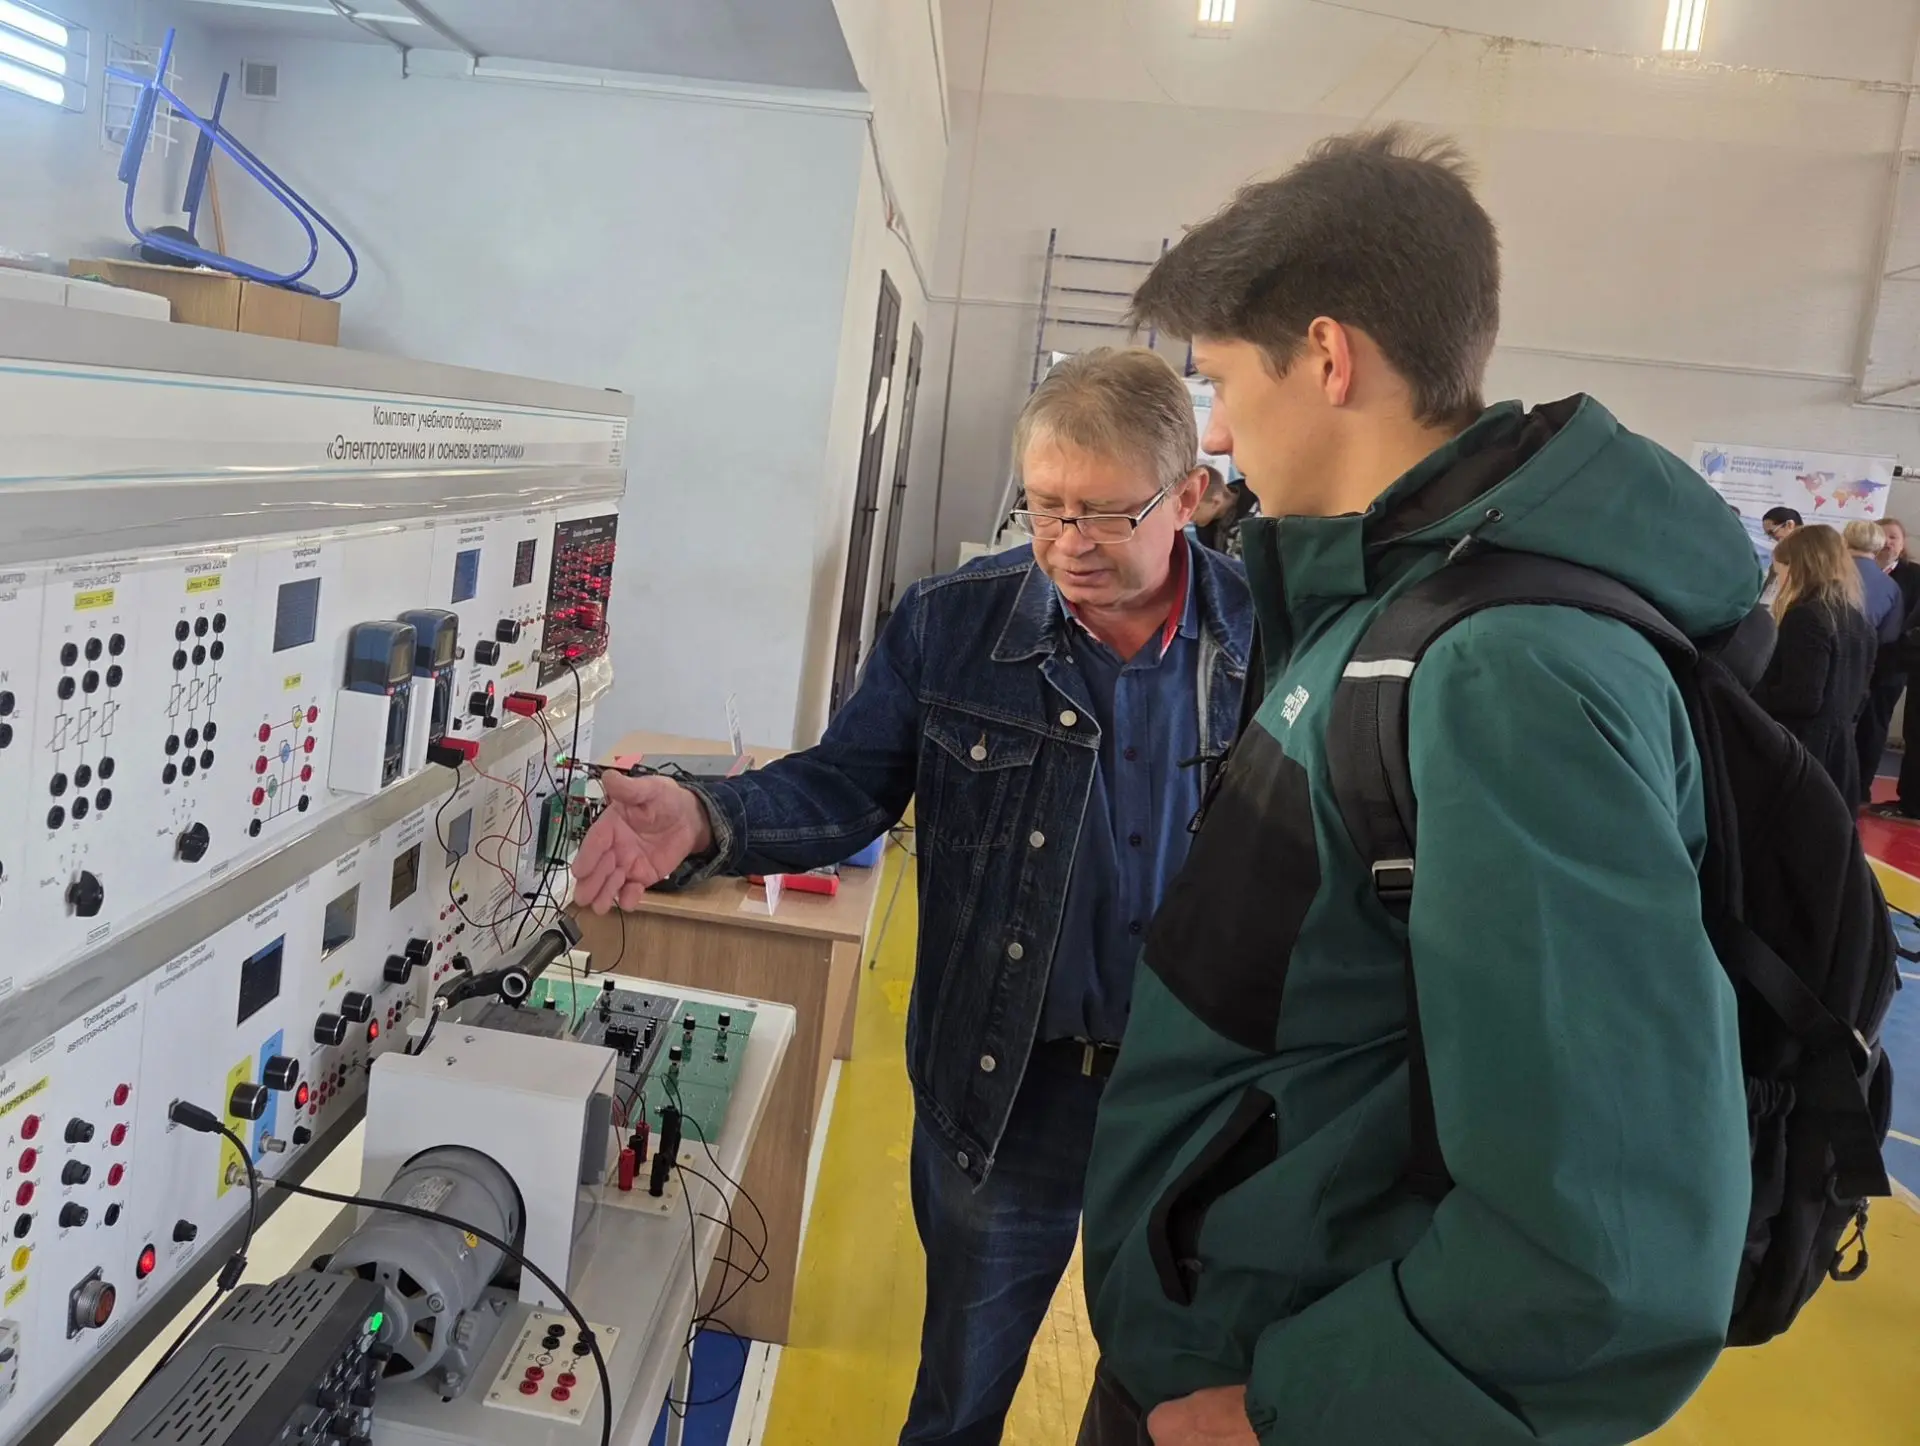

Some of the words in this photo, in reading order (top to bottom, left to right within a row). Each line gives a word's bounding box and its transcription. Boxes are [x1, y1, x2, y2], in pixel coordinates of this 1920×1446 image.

[373, 405, 416, 427] Комплект
[417, 410, 454, 432] учебного
[454, 411, 502, 434] оборудования
[326, 434, 426, 466] «Электротехника
[428, 443, 435, 460] и
[437, 441, 471, 462] основы
[472, 442, 524, 464] электроники»
